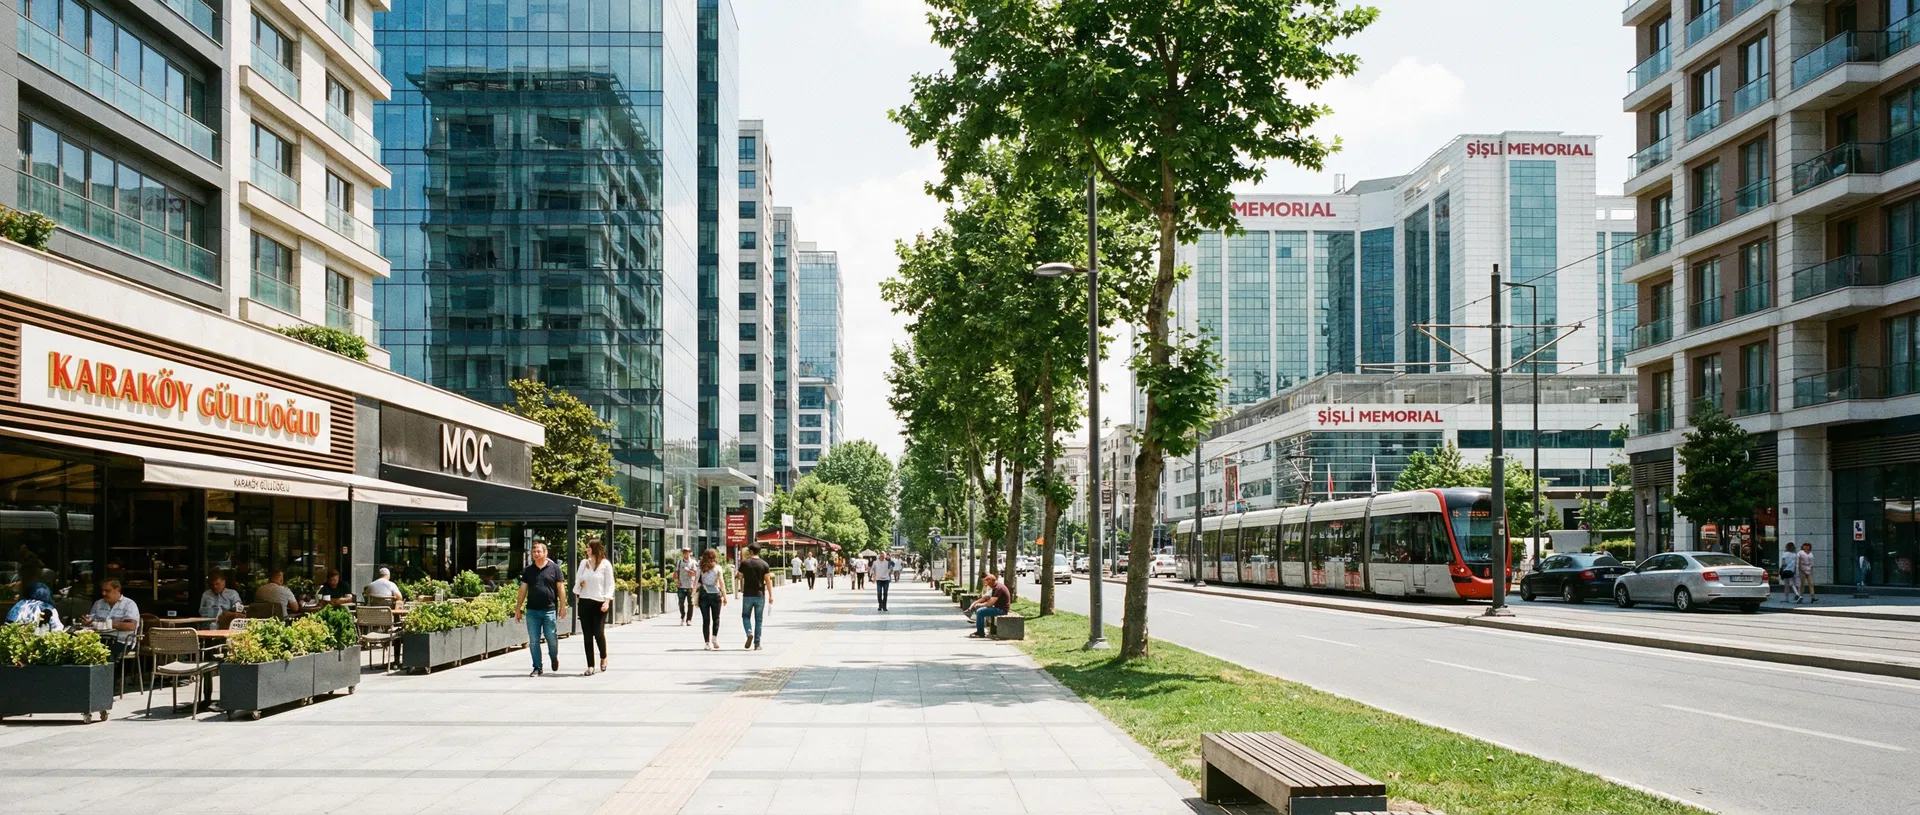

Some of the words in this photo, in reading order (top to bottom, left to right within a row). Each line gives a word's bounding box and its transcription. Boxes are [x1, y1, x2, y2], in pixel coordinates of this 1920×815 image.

[1466, 140, 1503, 159] ŞİŞLİ
[1507, 142, 1593, 156] MEMORIAL
[1231, 201, 1336, 217] MEMORIAL
[48, 351, 193, 412] KARAKÖY
[197, 382, 321, 439] GÜLLÜOĞLU
[1317, 406, 1355, 426] ŞİŞLİ
[1358, 410, 1444, 423] MEMORIAL
[440, 423, 493, 476] MOC
